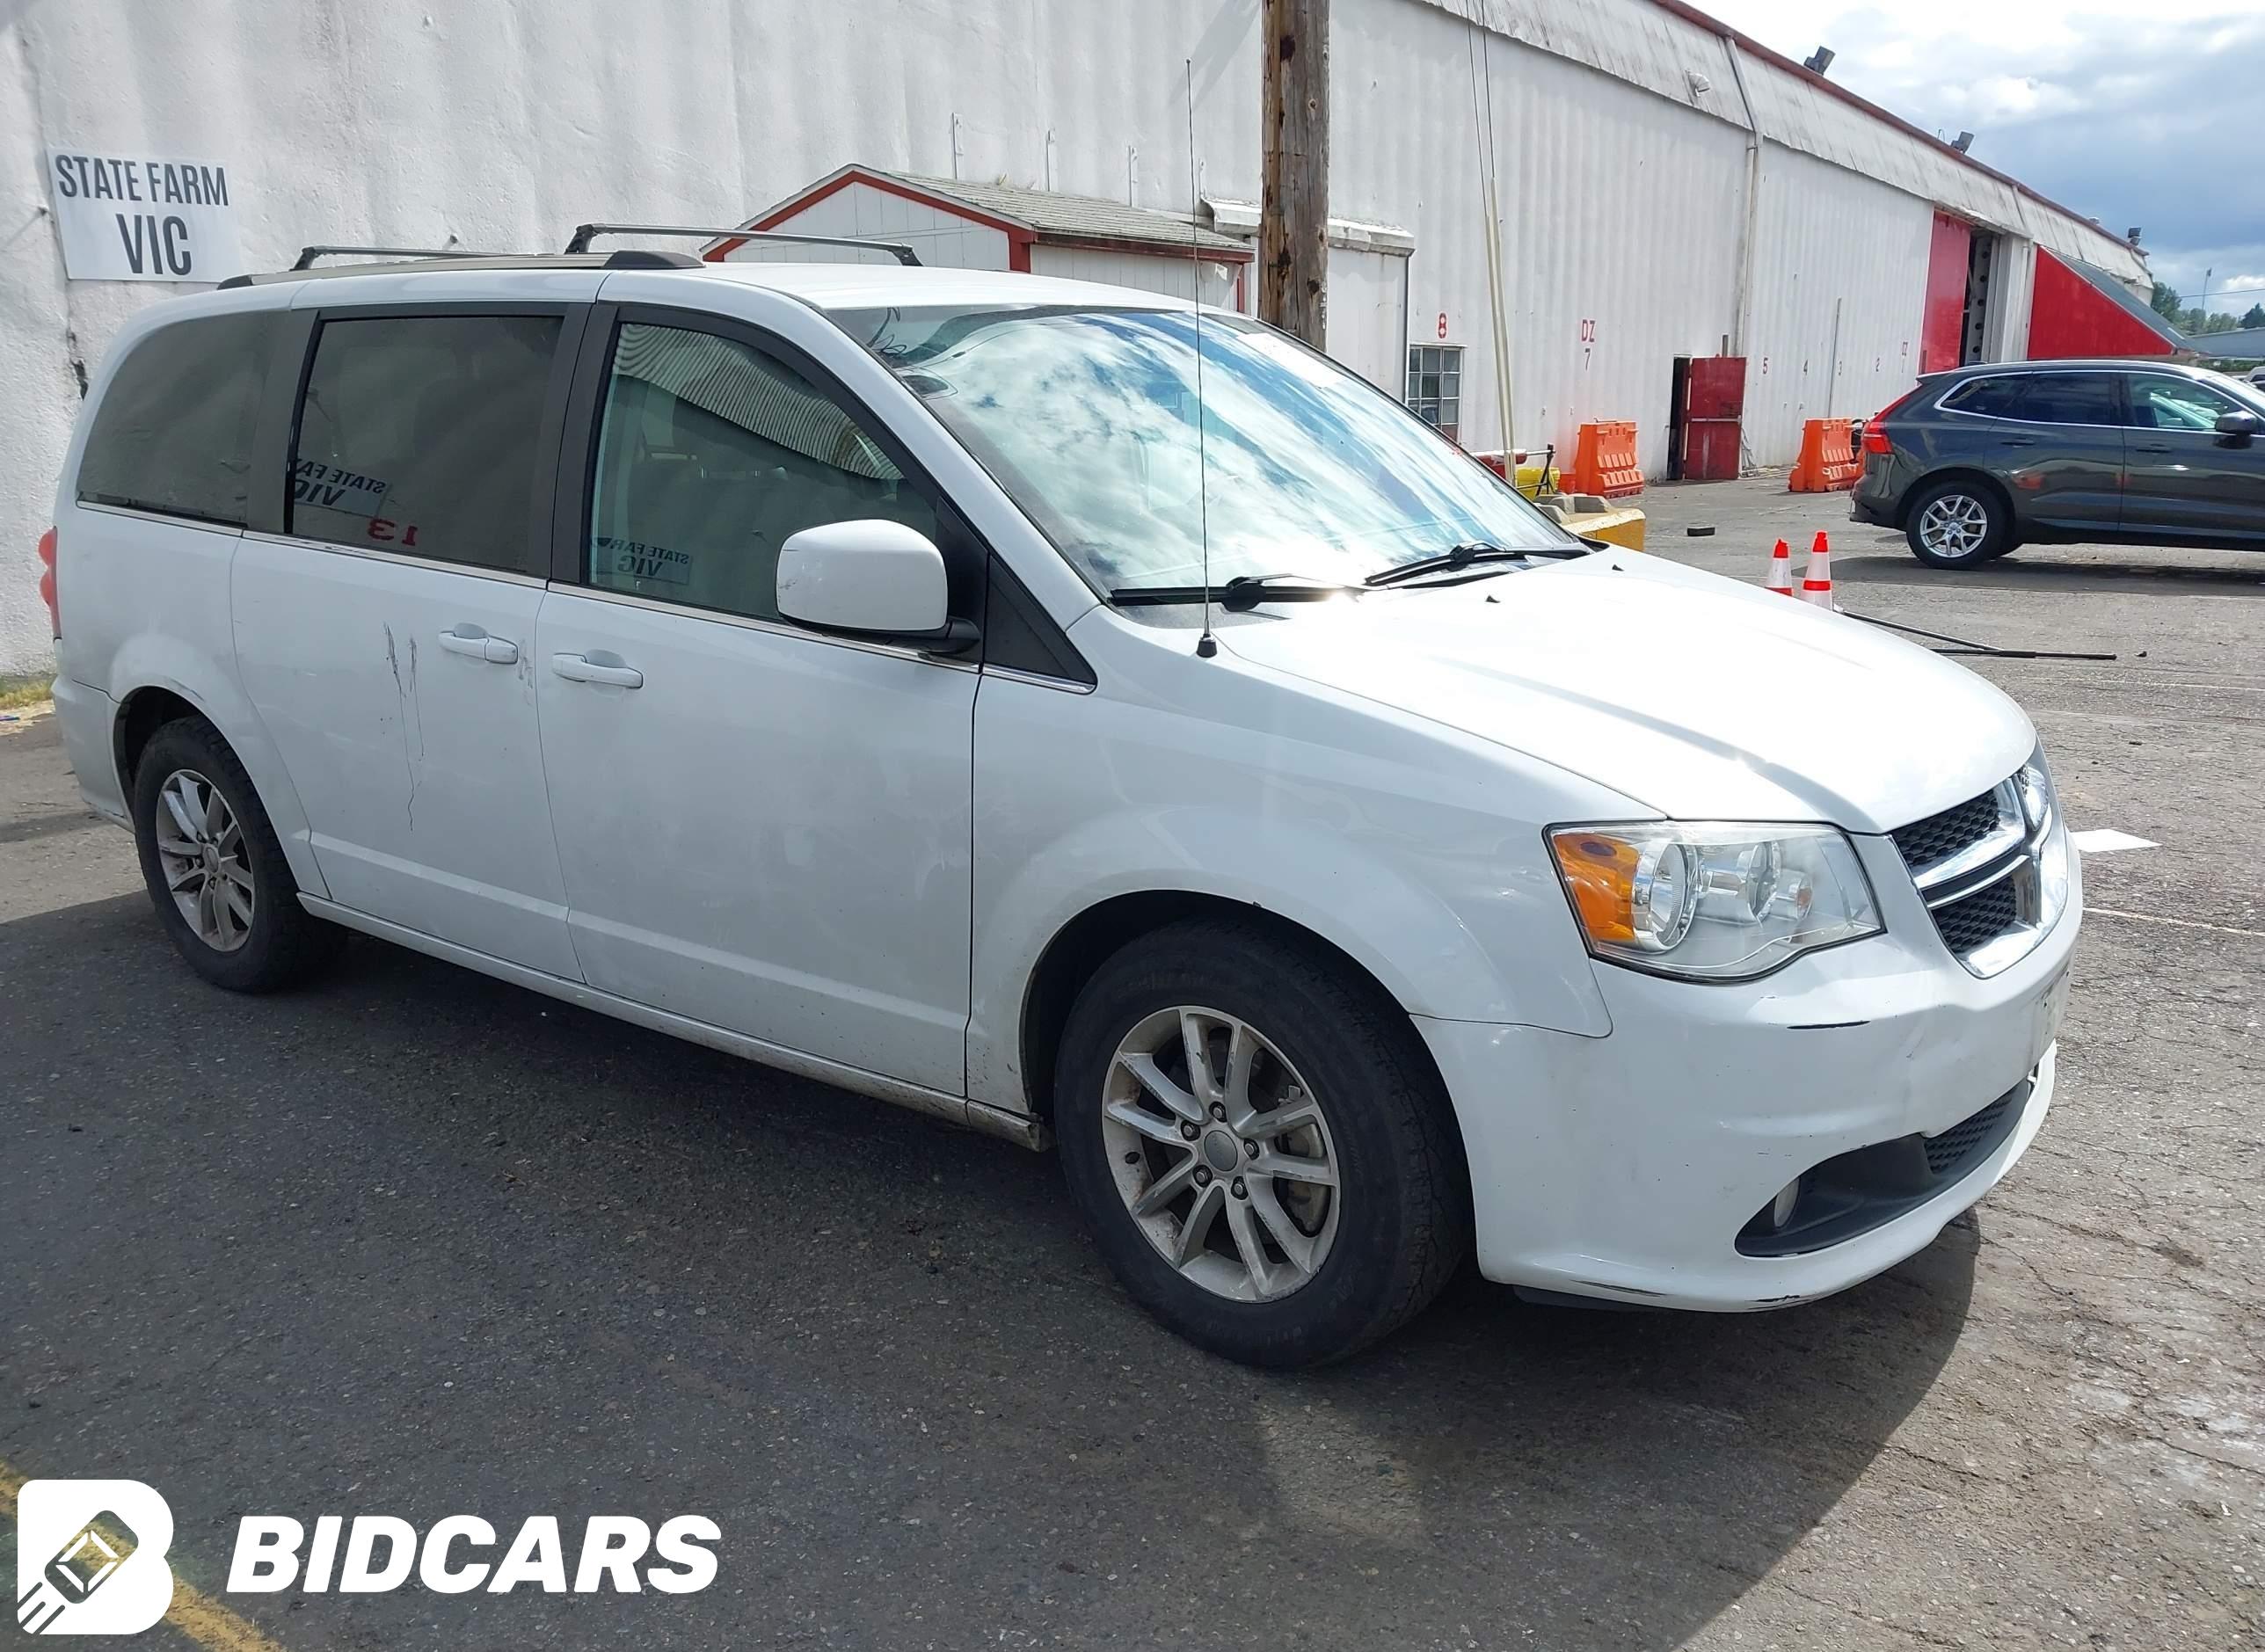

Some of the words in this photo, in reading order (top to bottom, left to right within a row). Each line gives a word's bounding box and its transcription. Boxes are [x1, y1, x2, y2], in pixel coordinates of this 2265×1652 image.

[55, 154, 142, 201] STATE
[145, 162, 229, 207] FARM
[115, 213, 192, 276] VIC
[1438, 312, 1447, 339] 8
[1584, 348, 1591, 371] 7
[1762, 357, 1769, 375] 5
[1803, 359, 1809, 376] 4
